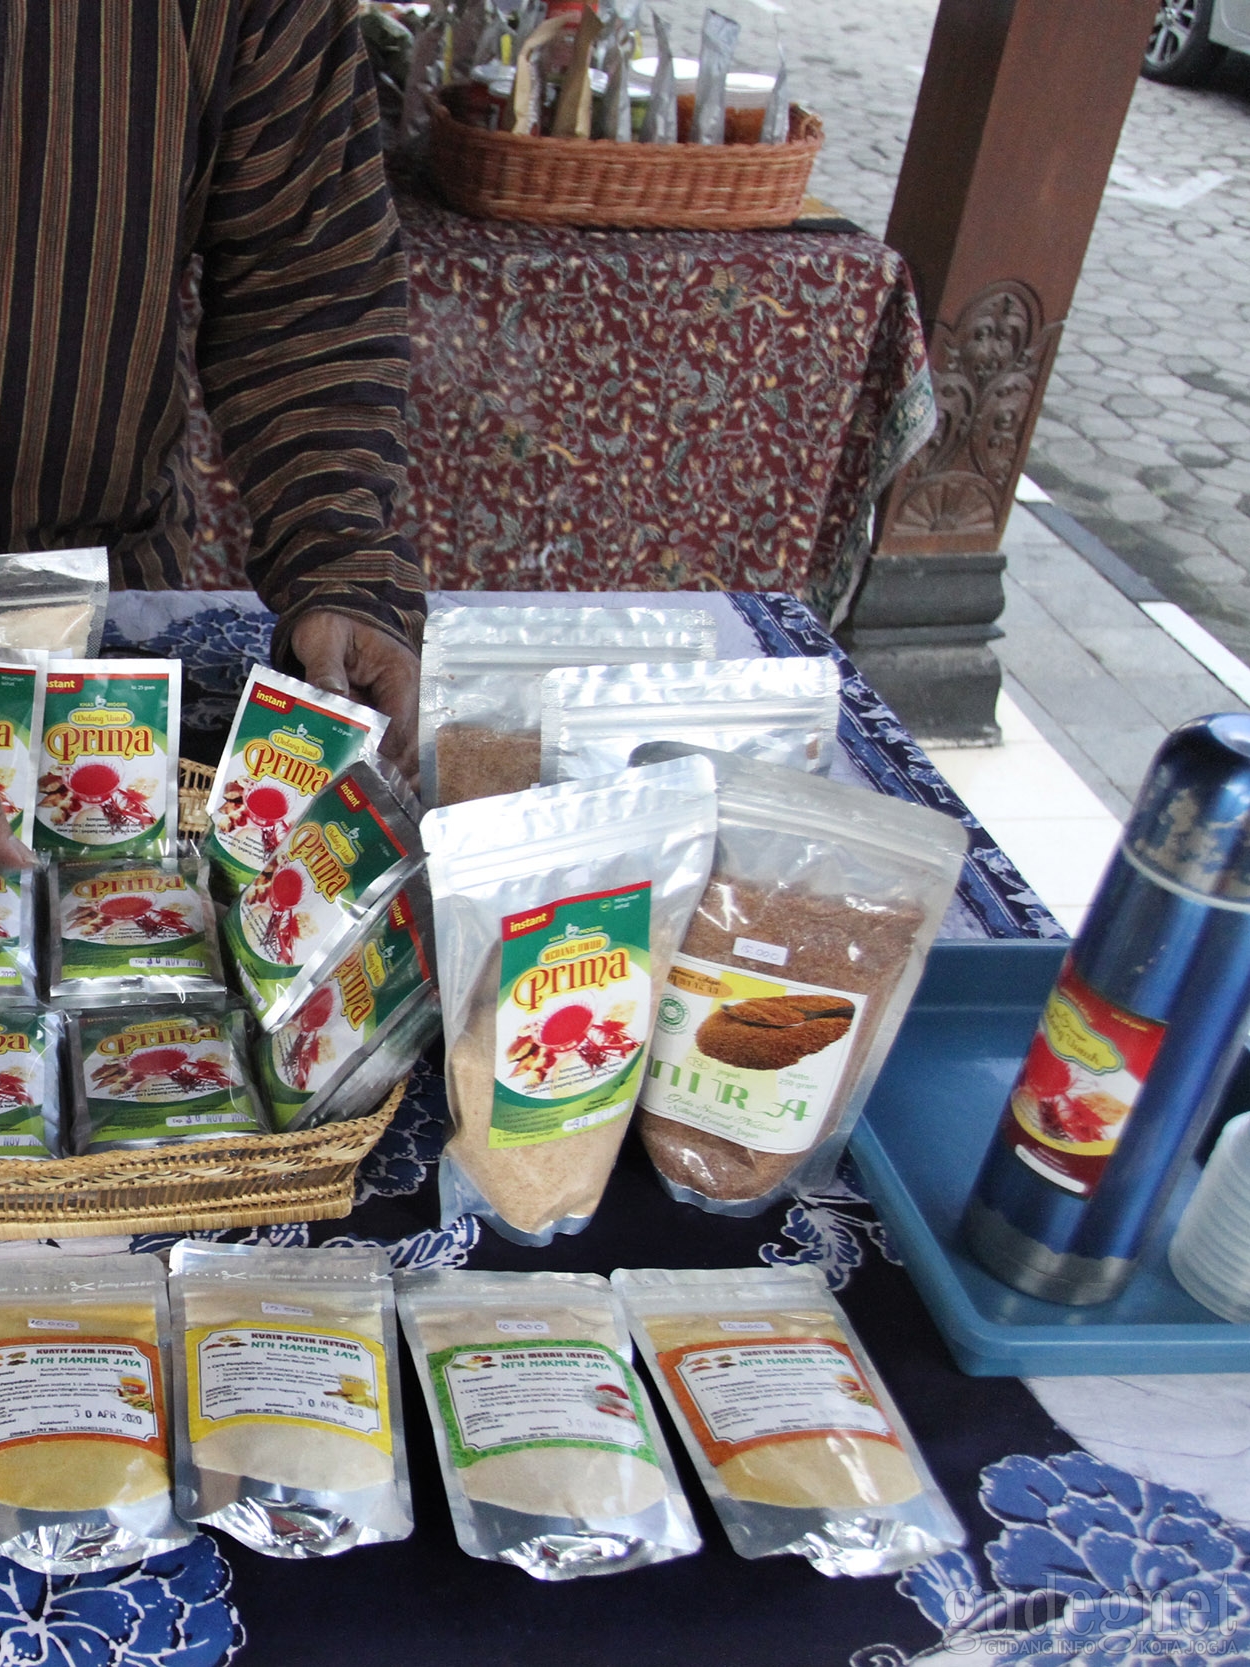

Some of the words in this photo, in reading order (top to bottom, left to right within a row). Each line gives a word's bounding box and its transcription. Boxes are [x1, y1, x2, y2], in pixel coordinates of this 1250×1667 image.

[47, 680, 75, 688] stant
[256, 690, 287, 709] instant
[74, 714, 104, 724] Wedang
[47, 727, 151, 762] Prima
[245, 742, 329, 793] Prima
[340, 783, 361, 807] instant
[290, 825, 348, 898] Prima
[75, 876, 182, 898] Prima
[510, 912, 548, 933] instant
[513, 951, 628, 1011] Prima
[100, 1025, 218, 1054] Prima
[3, 1137, 20, 1146] NOV
[279, 1343, 329, 1355] MAKMUR
[334, 1350, 361, 1361] JAYA
[286, 1335, 316, 1344] PUTIH
[319, 1339, 359, 1351] INSTANT
[114, 1359, 141, 1368] JAYA
[501, 1361, 524, 1369] NTH
[585, 1362, 611, 1371] JAYA
[818, 1357, 845, 1366] JAYA
[320, 1401, 340, 1410] APR
[74, 1409, 92, 1418] 30
[98, 1410, 117, 1419] APR
[121, 1413, 142, 1425] 2020
